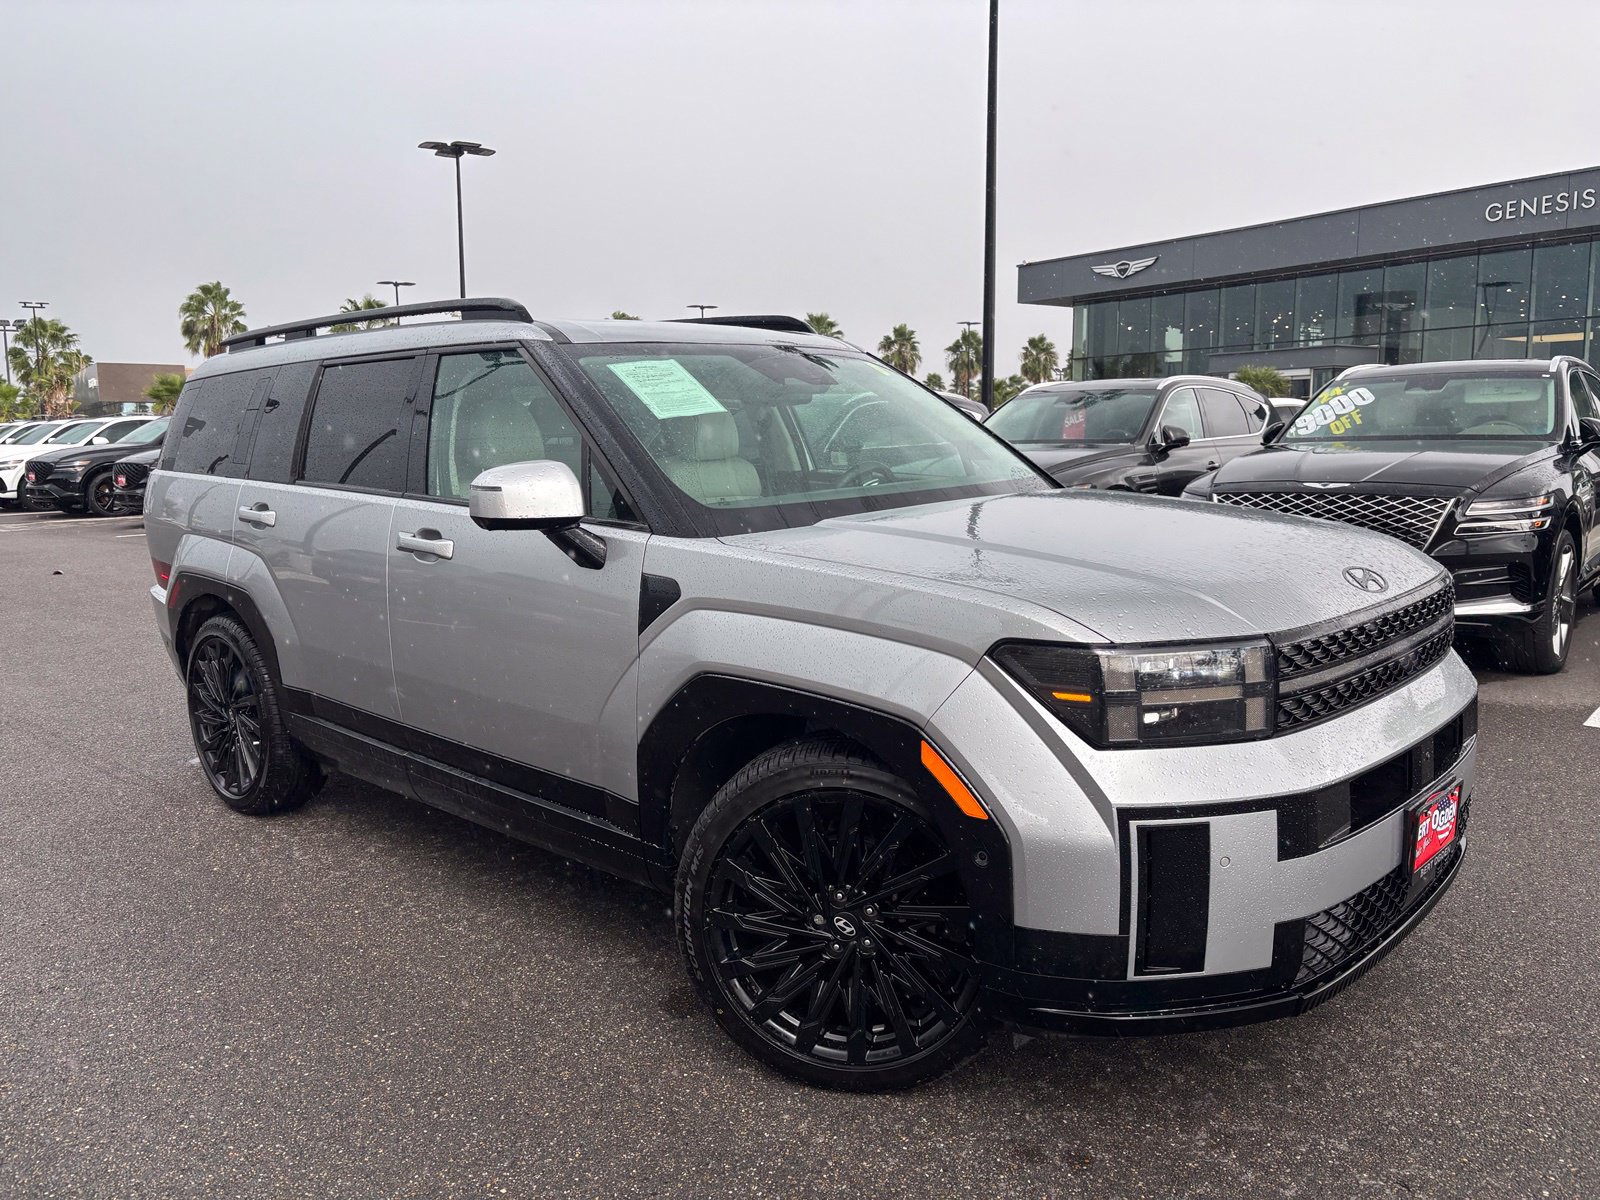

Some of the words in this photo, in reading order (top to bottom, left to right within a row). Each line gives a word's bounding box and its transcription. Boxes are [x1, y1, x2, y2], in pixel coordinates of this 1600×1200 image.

[1485, 188, 1596, 222] GENESIS
[1064, 410, 1085, 428] SALE
[1329, 409, 1363, 435] OFF
[1431, 801, 1457, 829] OGDEN
[1420, 860, 1434, 877] BERT
[1434, 846, 1450, 866] OGDEN
[683, 877, 704, 982] SCORPION
